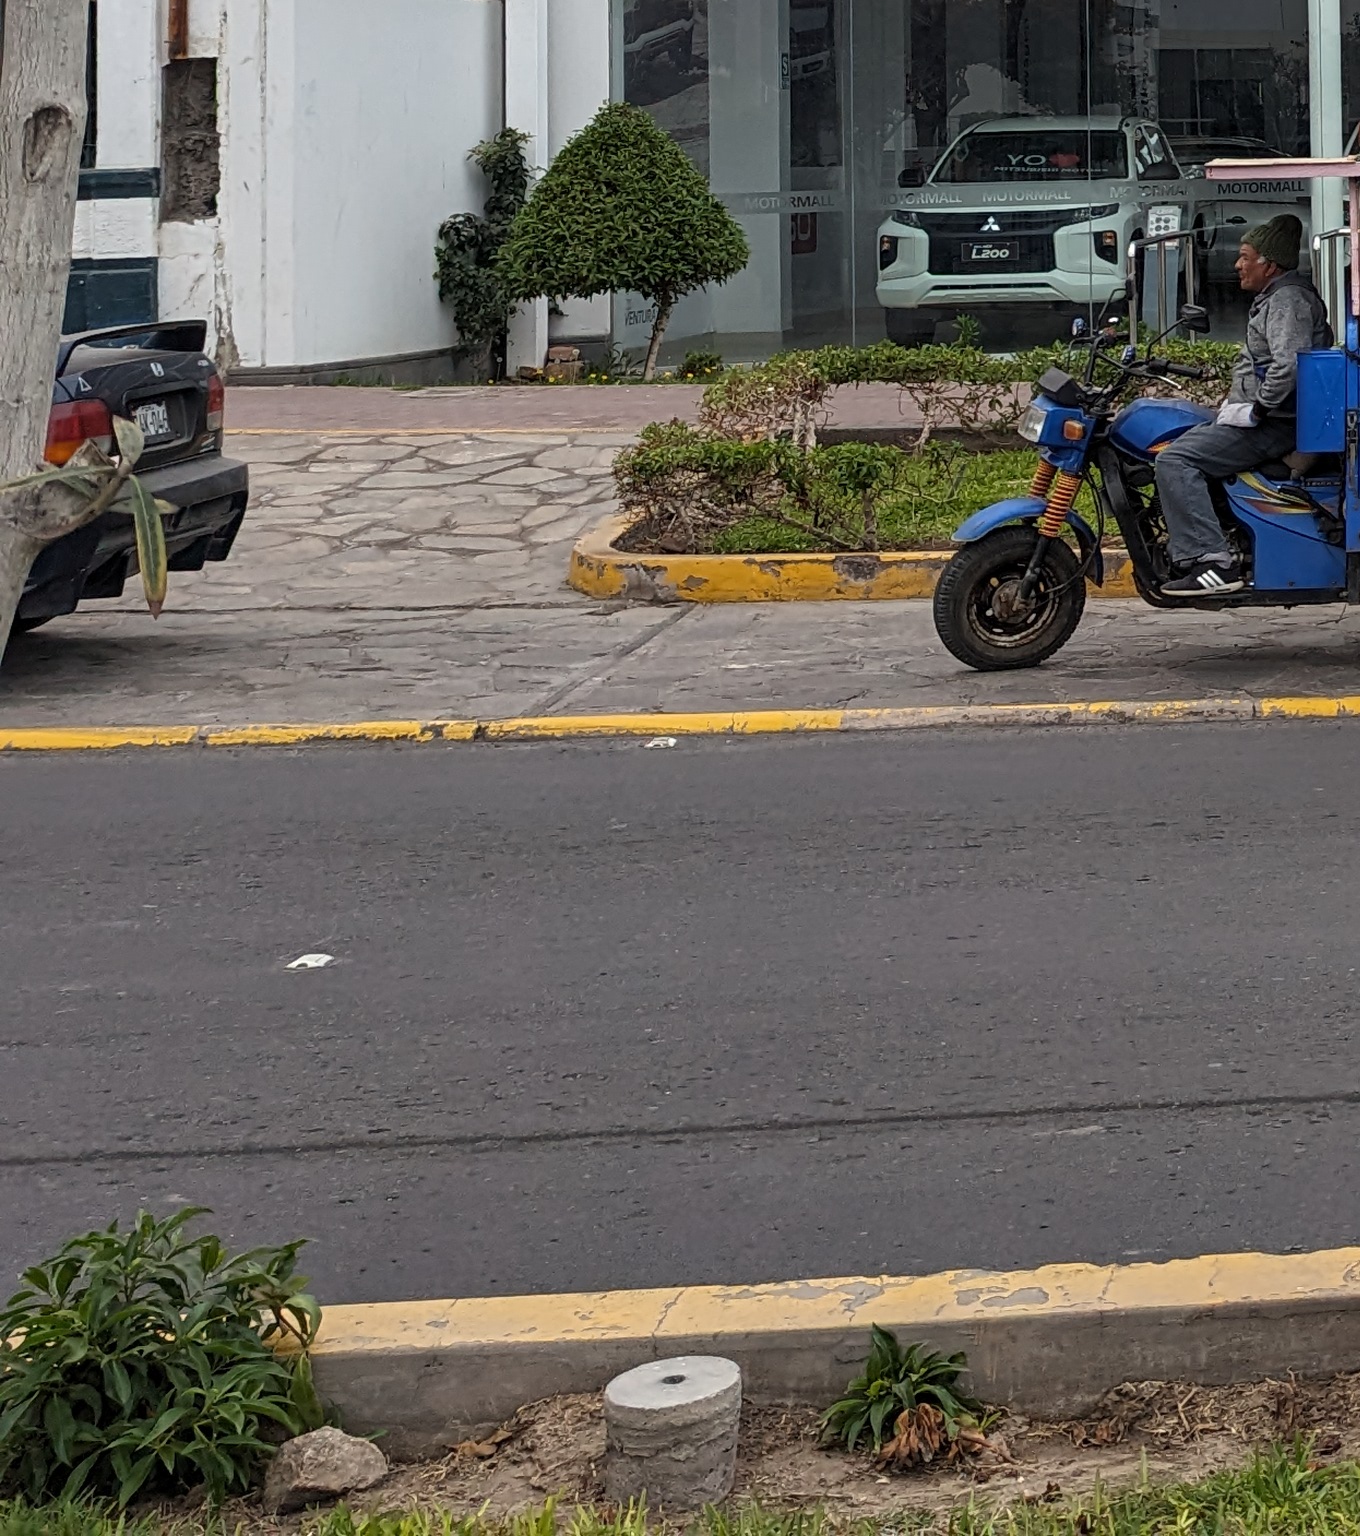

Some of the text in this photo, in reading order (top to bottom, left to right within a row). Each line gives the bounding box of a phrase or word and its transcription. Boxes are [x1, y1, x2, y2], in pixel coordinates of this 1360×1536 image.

[1007, 154, 1047, 166] YO
[1217, 181, 1305, 195] MOTORMALL
[983, 189, 1071, 202] MOTORMALL
[971, 248, 1010, 260] L200
